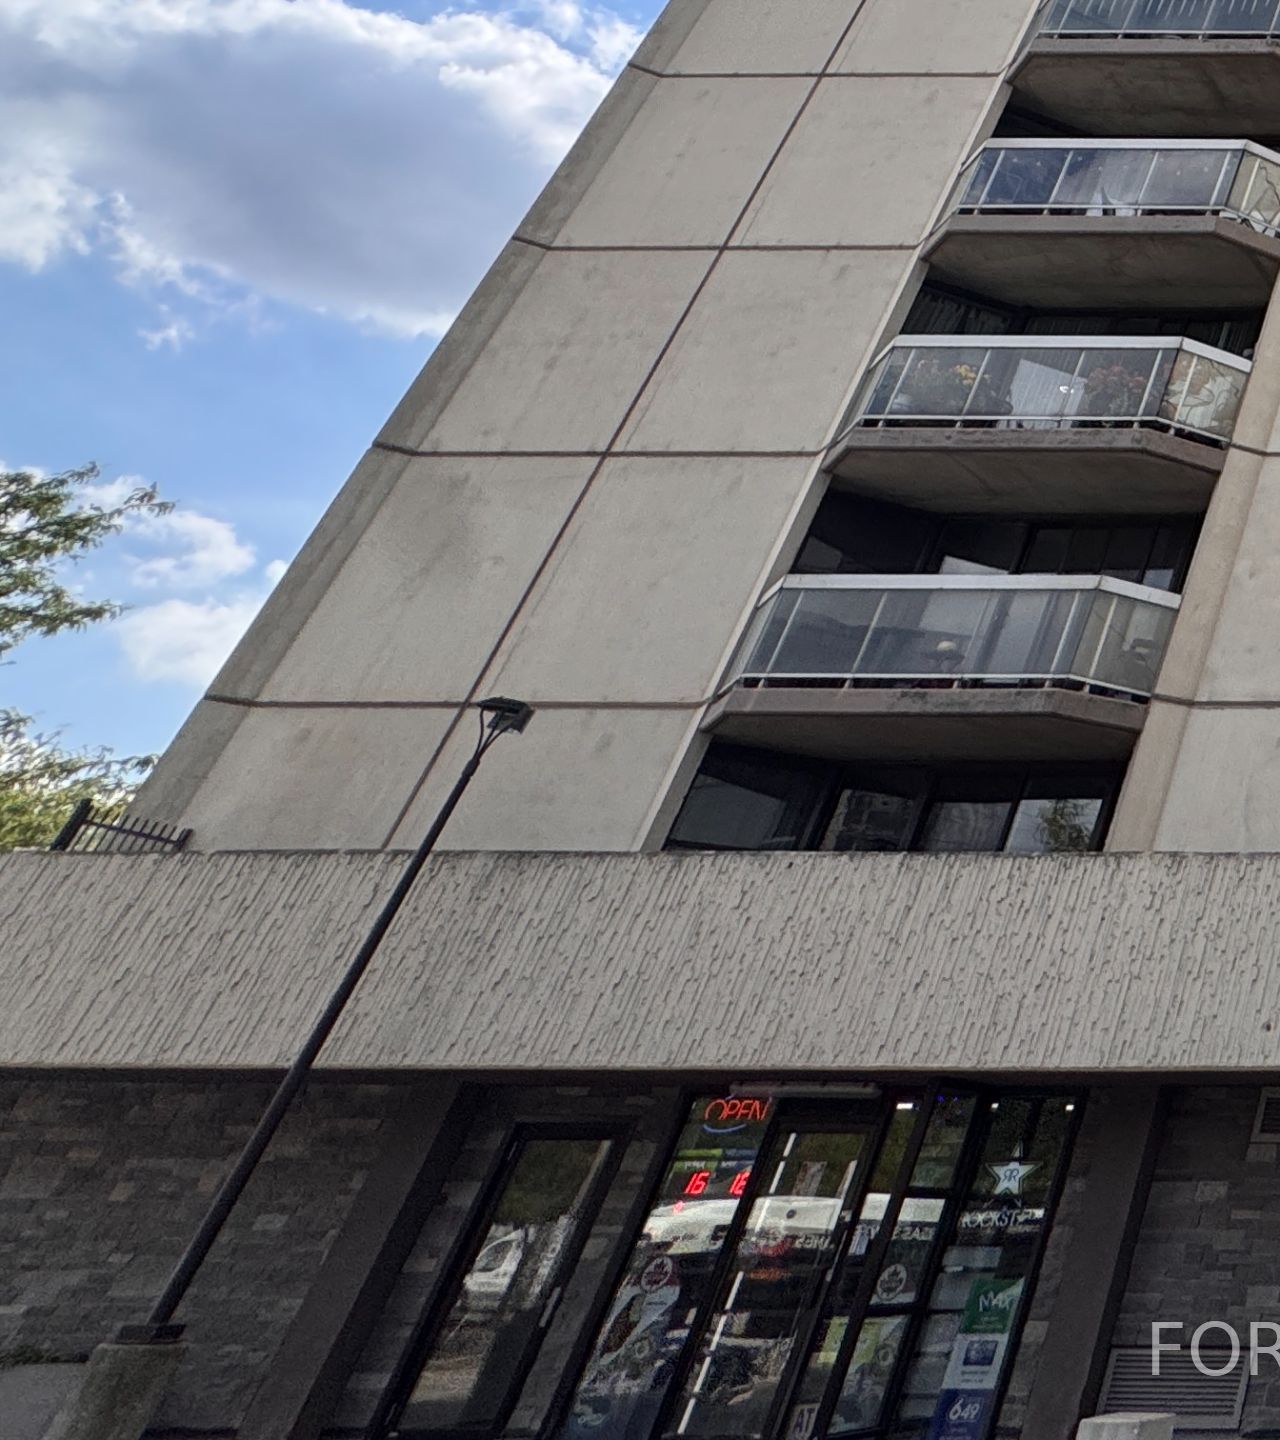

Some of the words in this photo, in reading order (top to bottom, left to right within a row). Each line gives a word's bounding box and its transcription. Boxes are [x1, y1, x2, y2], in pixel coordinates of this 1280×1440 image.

[704, 1098, 769, 1121] OPEN
[684, 1171, 710, 1194] 16
[961, 1208, 1042, 1228] ROCKST
[949, 1396, 980, 1420] 649
